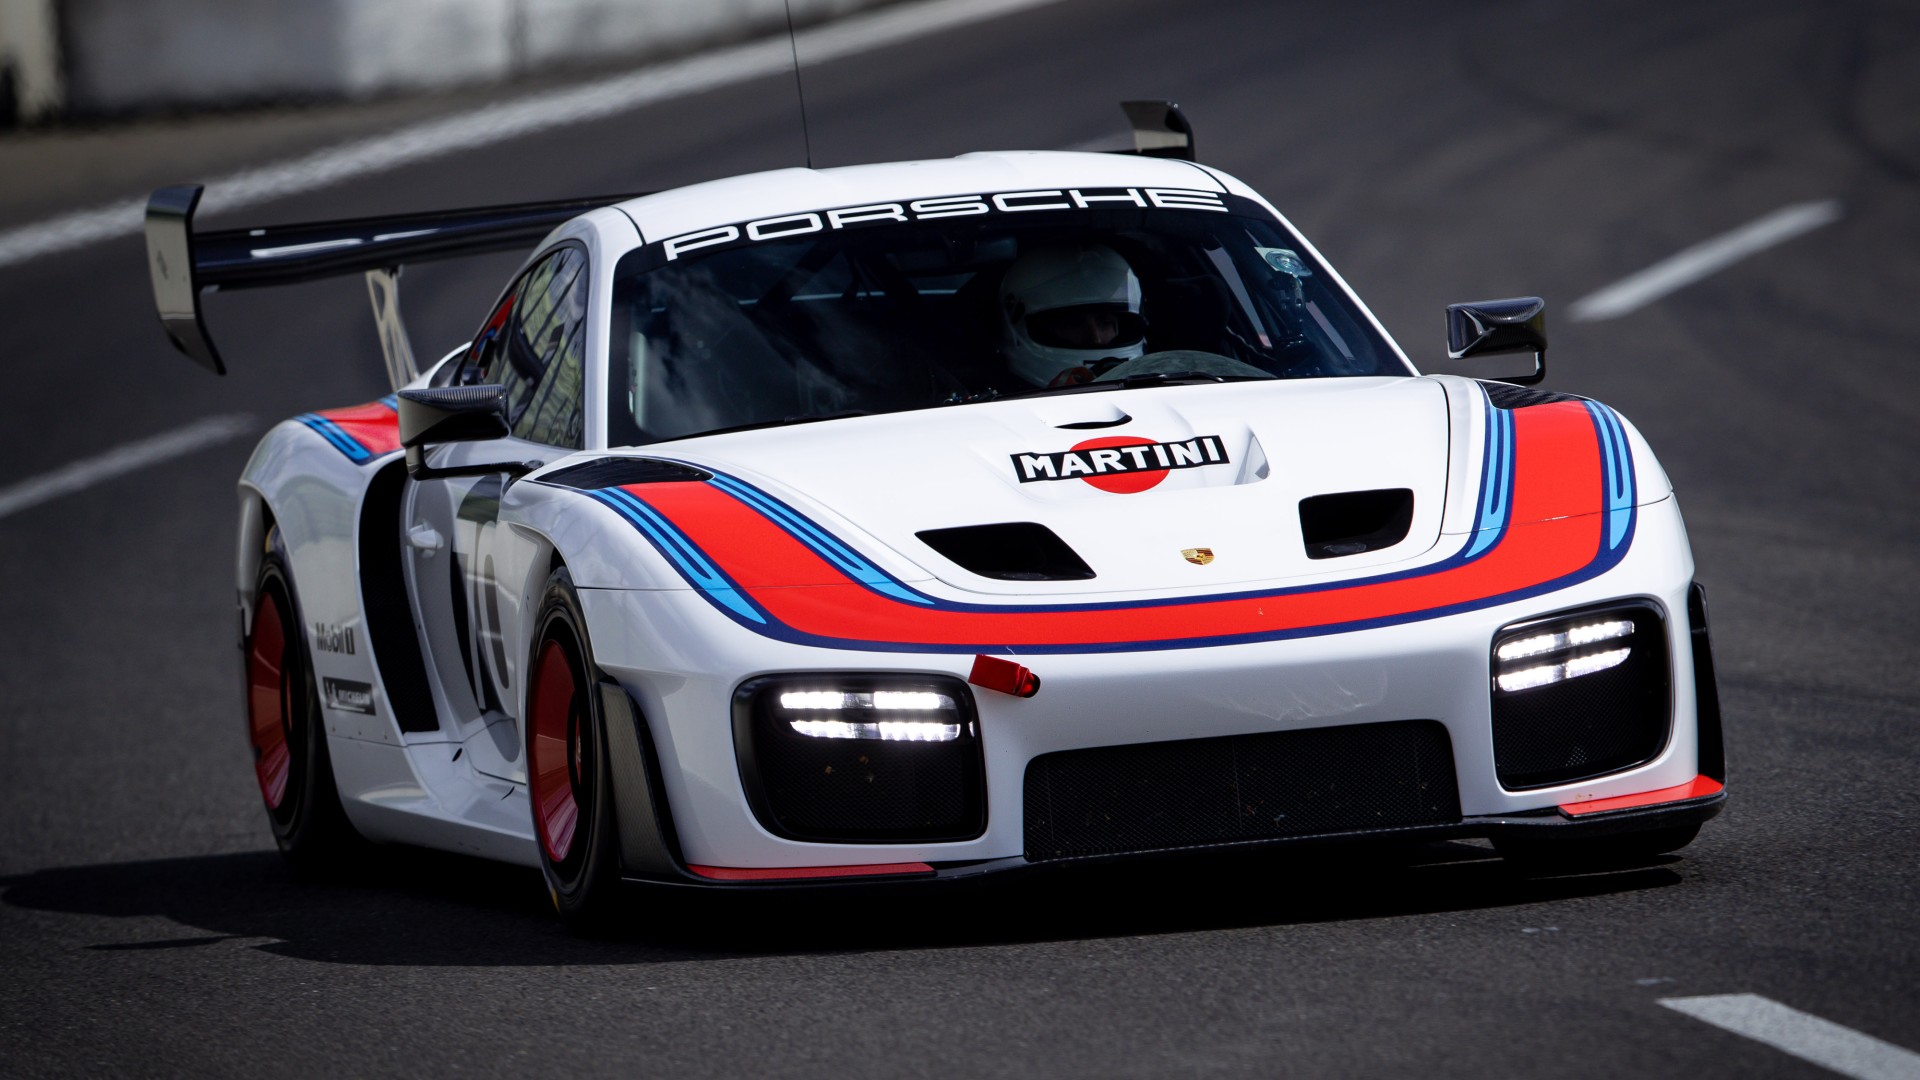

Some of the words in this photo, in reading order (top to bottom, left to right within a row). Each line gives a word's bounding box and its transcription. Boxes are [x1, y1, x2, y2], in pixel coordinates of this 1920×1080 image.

[664, 187, 1228, 262] PORSCHE
[1020, 438, 1221, 479] MARTINI
[316, 622, 345, 653] Mobil
